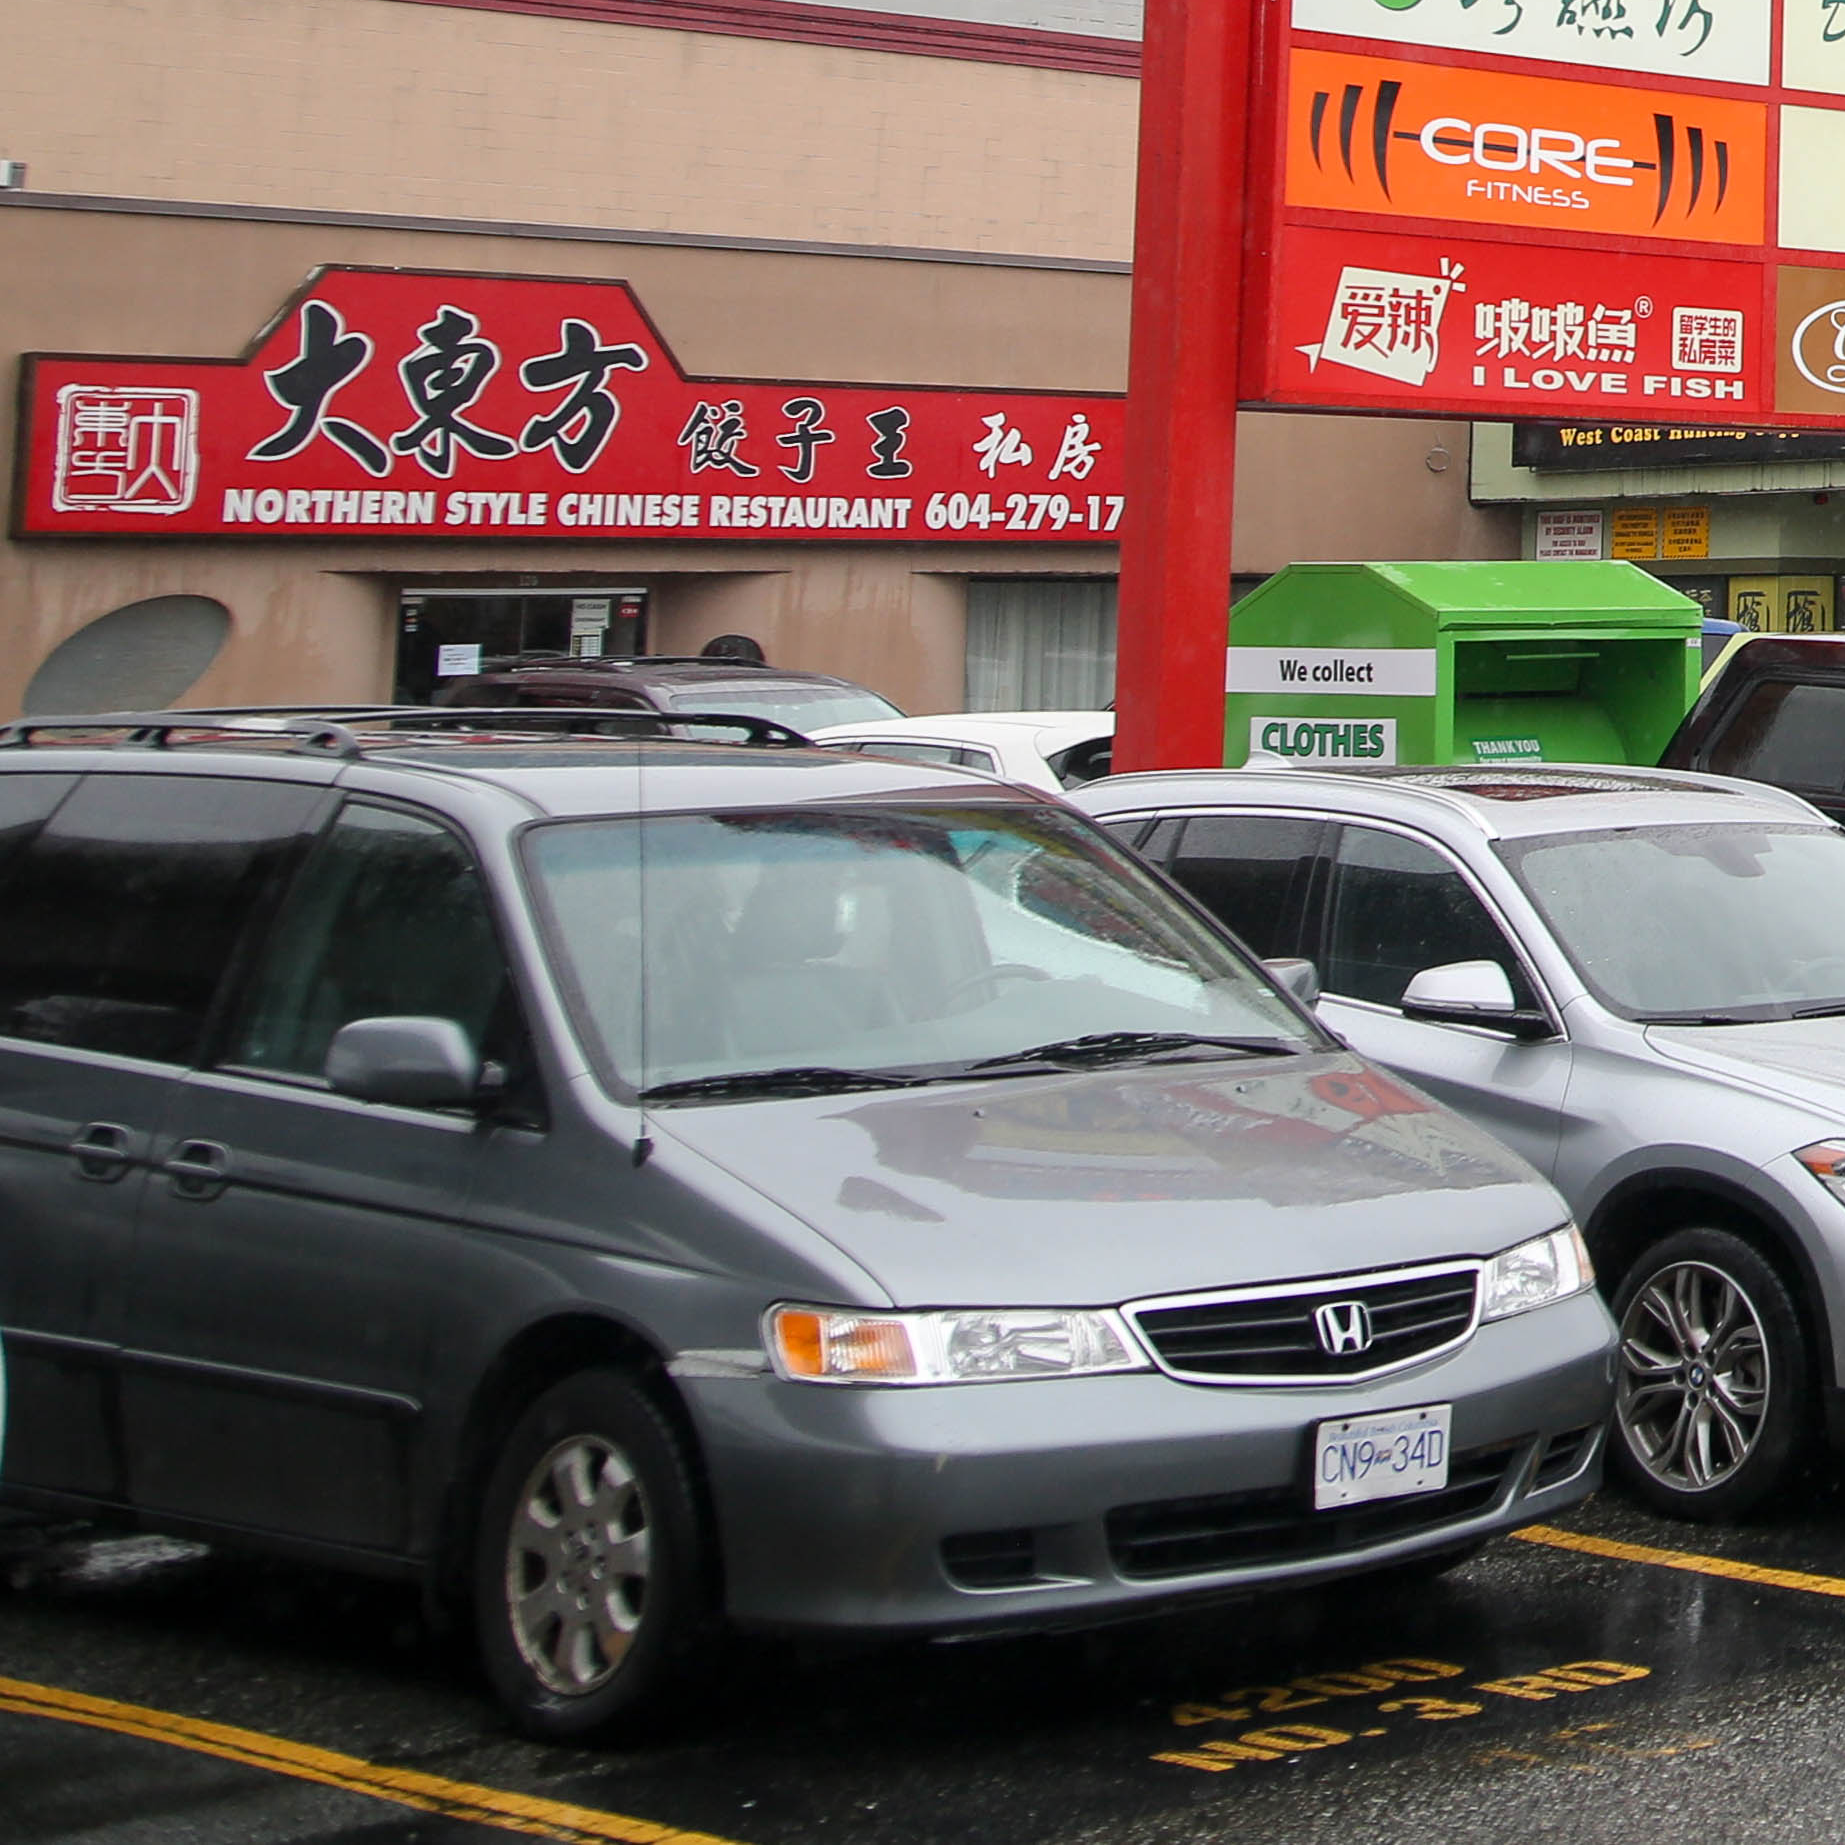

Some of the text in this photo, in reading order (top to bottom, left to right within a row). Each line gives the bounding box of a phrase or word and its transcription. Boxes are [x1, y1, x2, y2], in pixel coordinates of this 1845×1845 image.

[1420, 117, 1633, 186] CORE
[1466, 179, 1590, 209] FITNESS
[245, 299, 1102, 483] 大東方 餃子王 私房
[1473, 366, 1743, 400] I LOVE FISH
[1560, 428, 1602, 446] West
[222, 488, 433, 524] NORTHERN
[446, 491, 547, 525] STYLE
[558, 492, 700, 527] CHINESE
[710, 496, 912, 530] RESTAURANT
[1279, 659, 1373, 683] We collect
[1261, 723, 1384, 758] CLOTHES
[1472, 739, 1540, 754] THANK YOU
[1173, 1658, 1465, 1726] 4200
[1378, 1697, 1485, 1720] 3
[1472, 1660, 1651, 1700] RD
